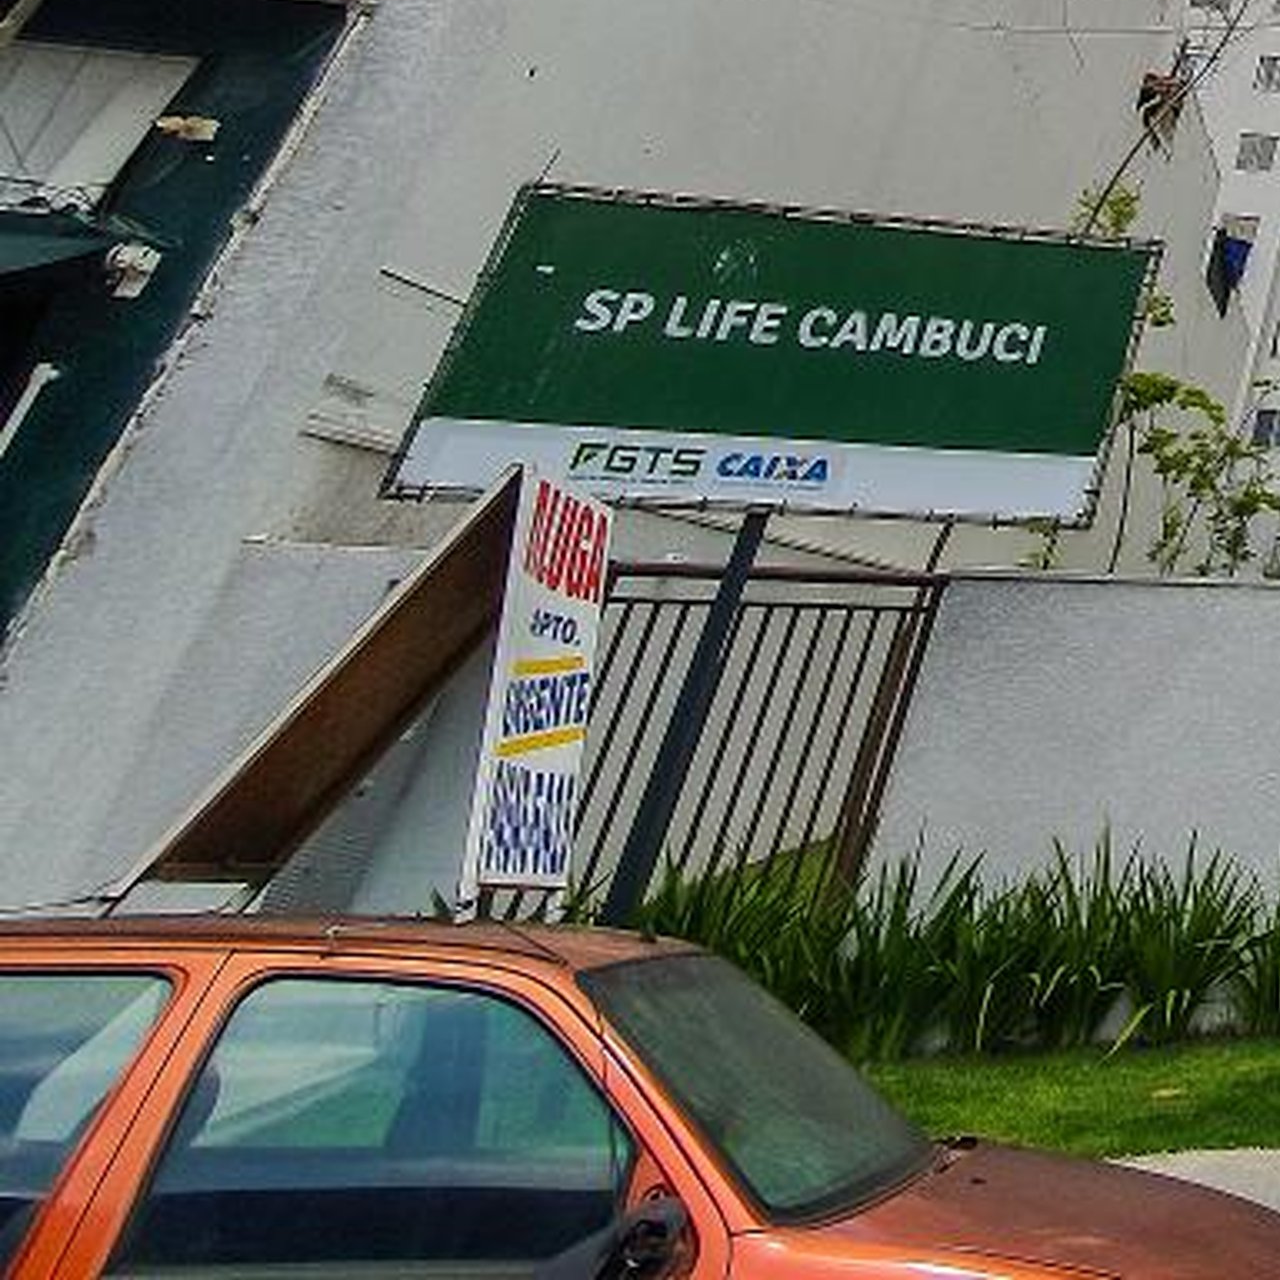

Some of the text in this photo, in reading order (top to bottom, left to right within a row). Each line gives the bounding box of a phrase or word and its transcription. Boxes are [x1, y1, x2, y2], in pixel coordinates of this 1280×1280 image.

[575, 289, 1047, 364] SP LIFE CAMBUCI
[570, 443, 828, 481] FGTS CAIXA
